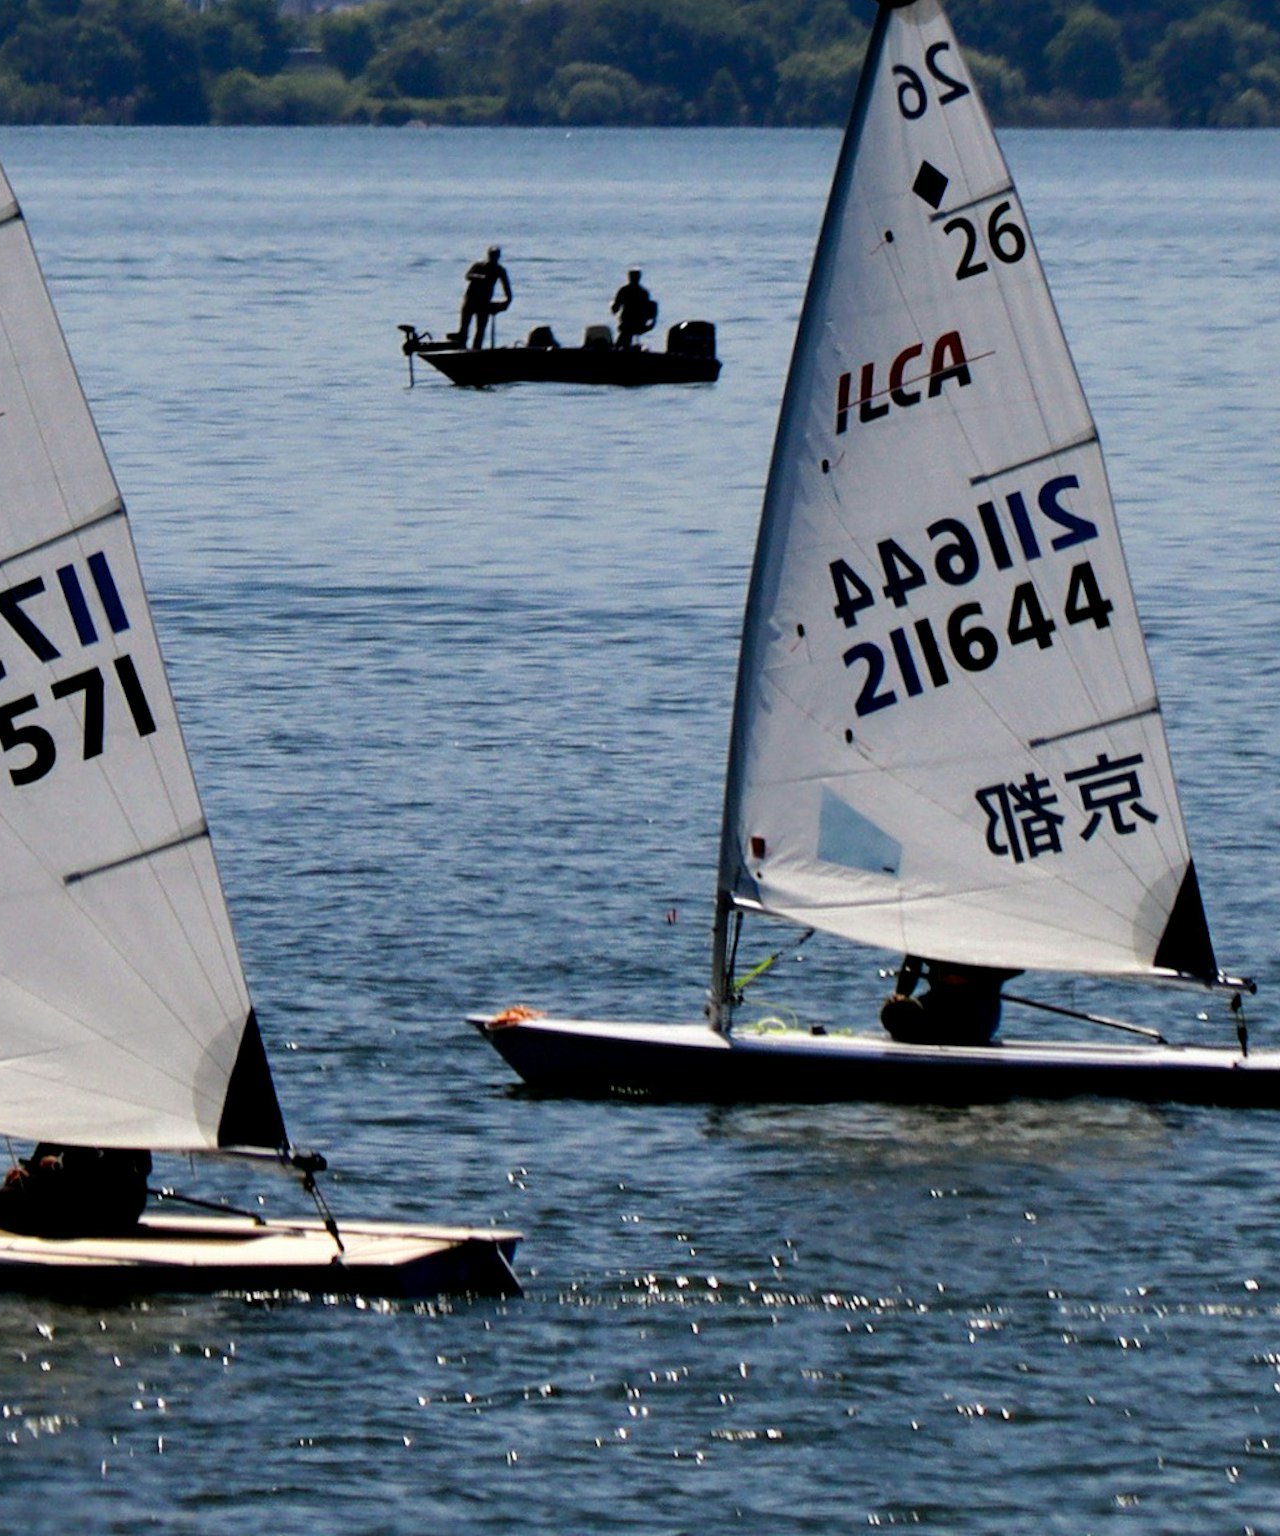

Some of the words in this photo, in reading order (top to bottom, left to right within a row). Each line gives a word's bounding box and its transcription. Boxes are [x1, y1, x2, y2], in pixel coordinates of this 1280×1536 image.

[943, 202, 1026, 280] 26
[836, 331, 972, 434] ILCA
[842, 561, 1113, 717] 211644
